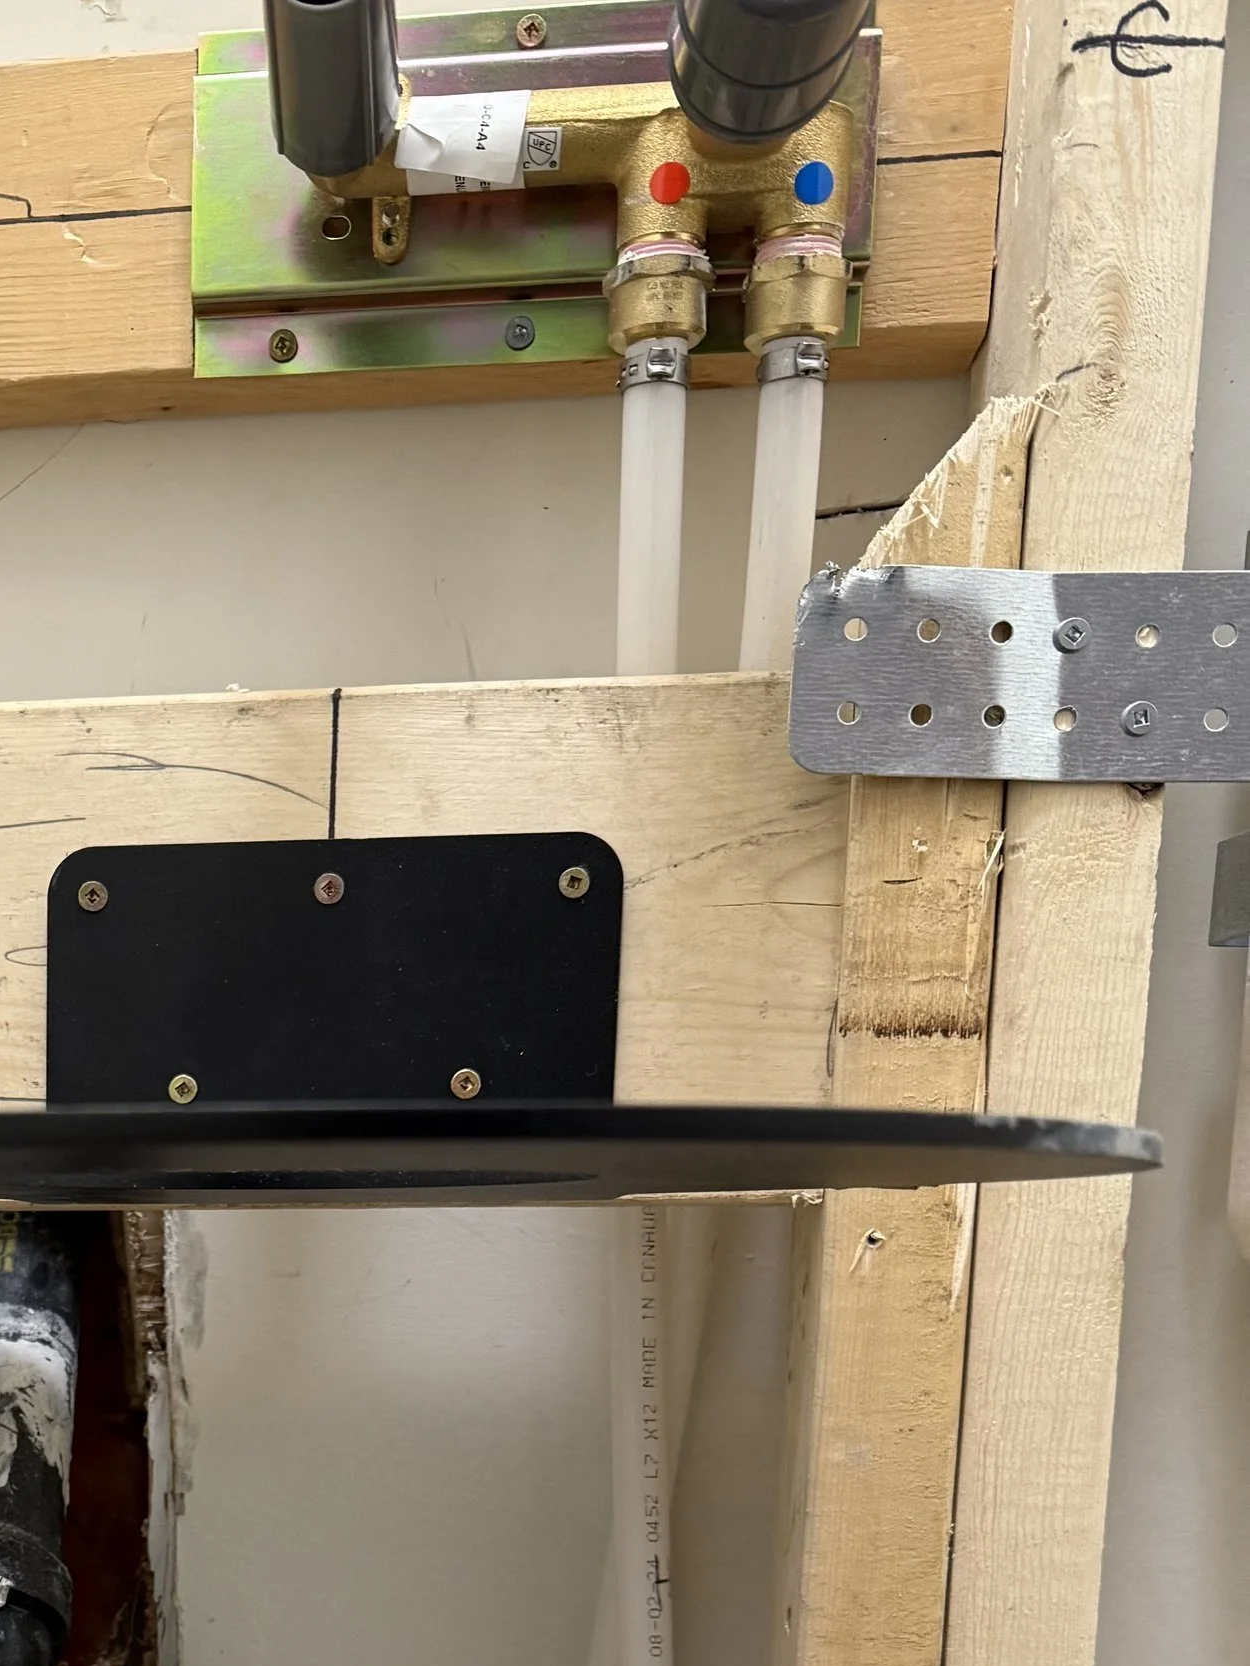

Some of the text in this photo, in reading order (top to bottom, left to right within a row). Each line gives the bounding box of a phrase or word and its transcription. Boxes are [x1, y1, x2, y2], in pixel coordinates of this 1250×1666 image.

[532, 138, 551, 151] UPC
[641, 1298, 656, 1319] IN
[642, 1337, 657, 1388] MADE
